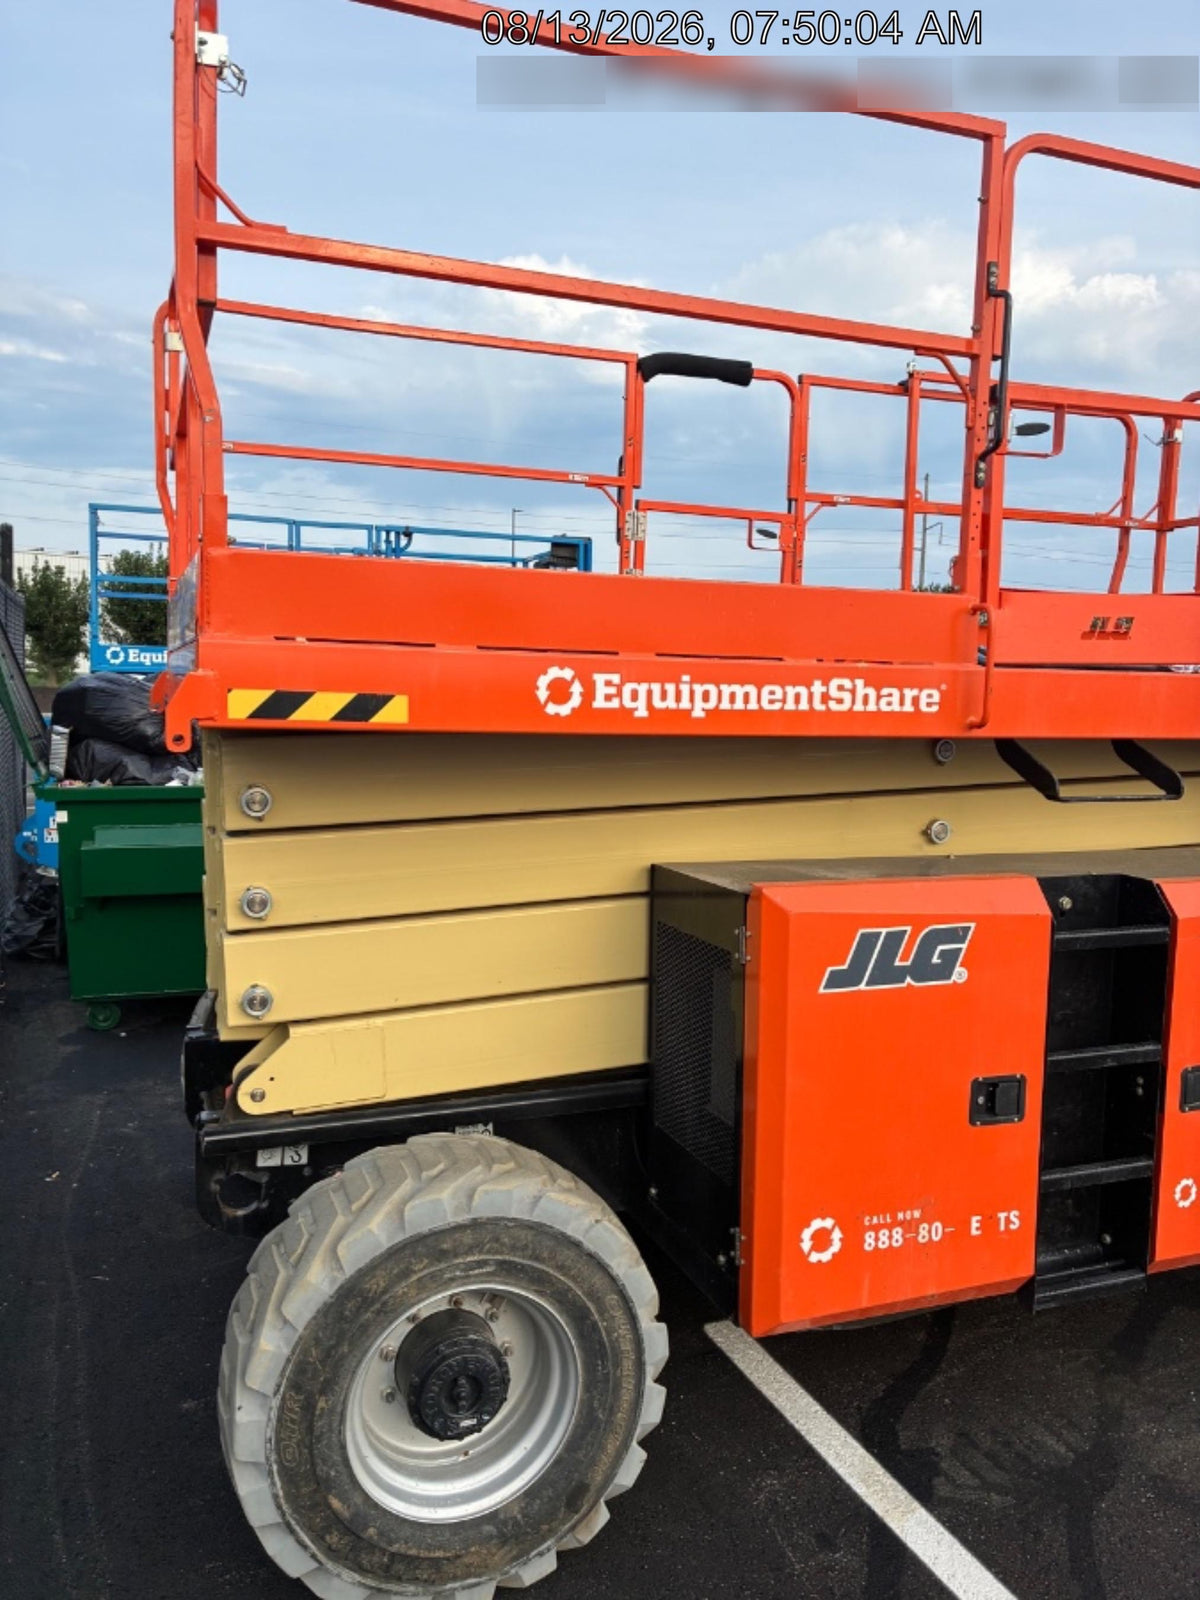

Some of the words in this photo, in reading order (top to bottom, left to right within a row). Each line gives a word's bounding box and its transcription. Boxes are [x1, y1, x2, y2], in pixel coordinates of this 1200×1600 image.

[1081, 616, 1135, 640] JLG
[592, 673, 942, 717] EquipmentShare
[818, 922, 976, 994] JLG
[864, 1214, 892, 1226] CALL
[897, 1209, 922, 1221] NOW
